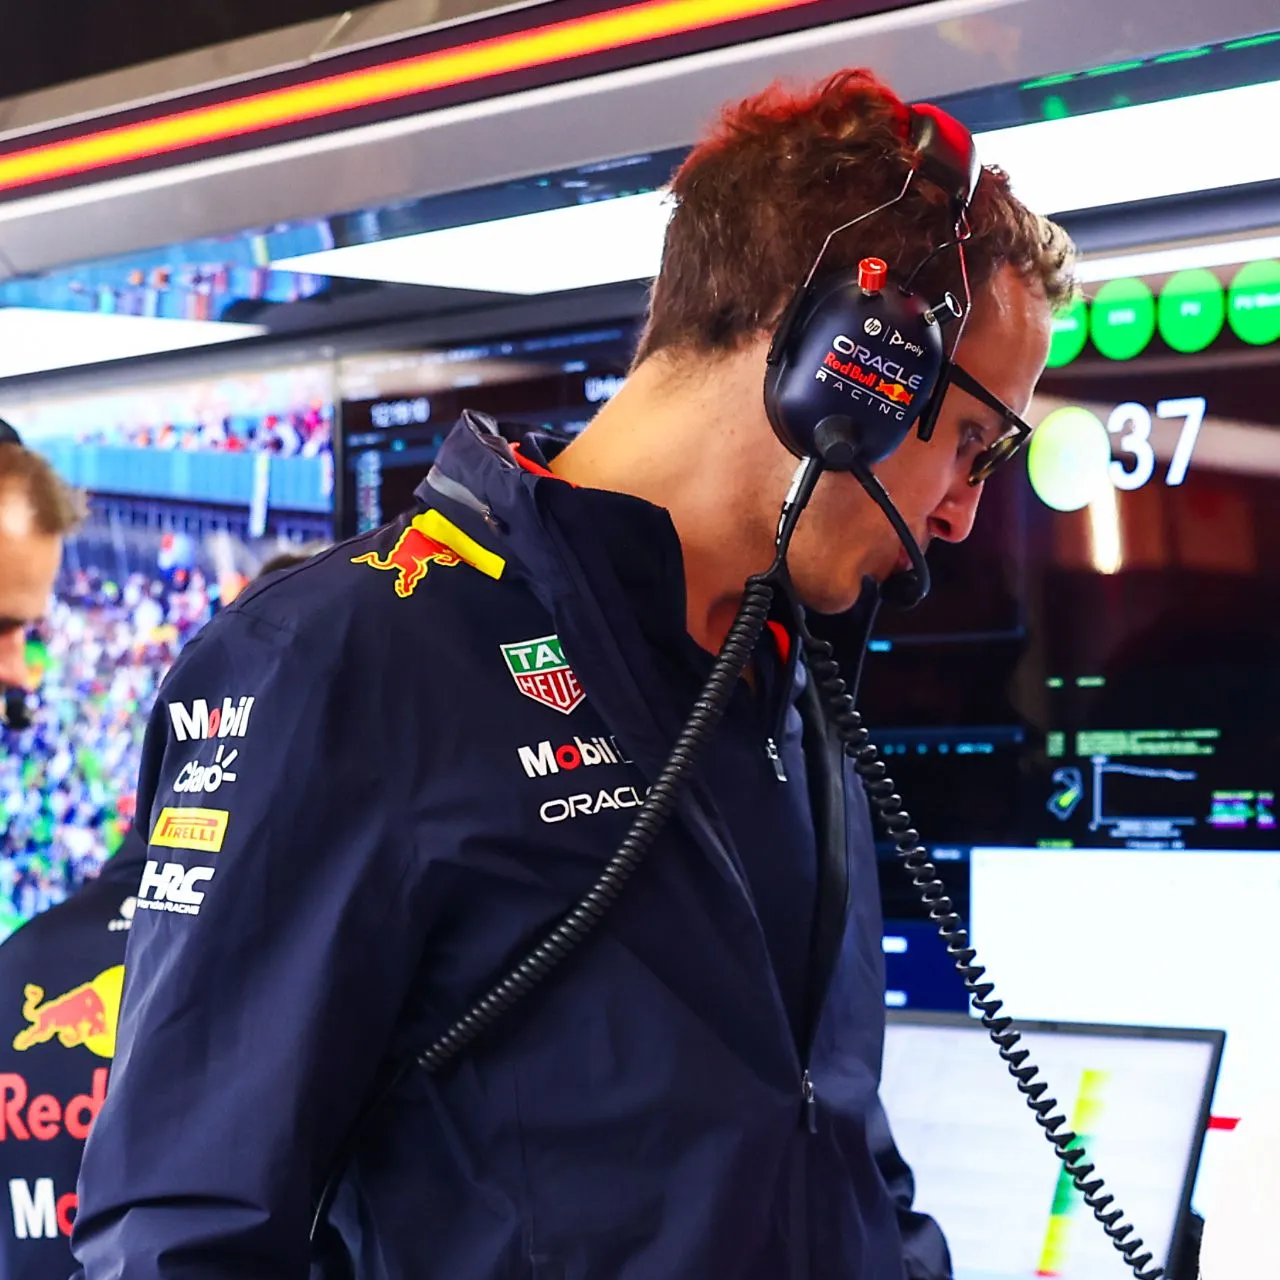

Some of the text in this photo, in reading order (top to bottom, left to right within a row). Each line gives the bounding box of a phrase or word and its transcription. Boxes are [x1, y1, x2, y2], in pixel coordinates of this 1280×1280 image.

[824, 352, 879, 387] Red Bull
[833, 335, 923, 390] ORACLE
[815, 369, 905, 420] RACING
[509, 643, 567, 670] TA
[521, 670, 582, 708] HEUE
[169, 696, 255, 741] Mobil
[517, 736, 618, 778] Mobil
[540, 786, 652, 823] ORACL
[160, 817, 219, 842] PIRELLI
[137, 860, 216, 905] HRC
